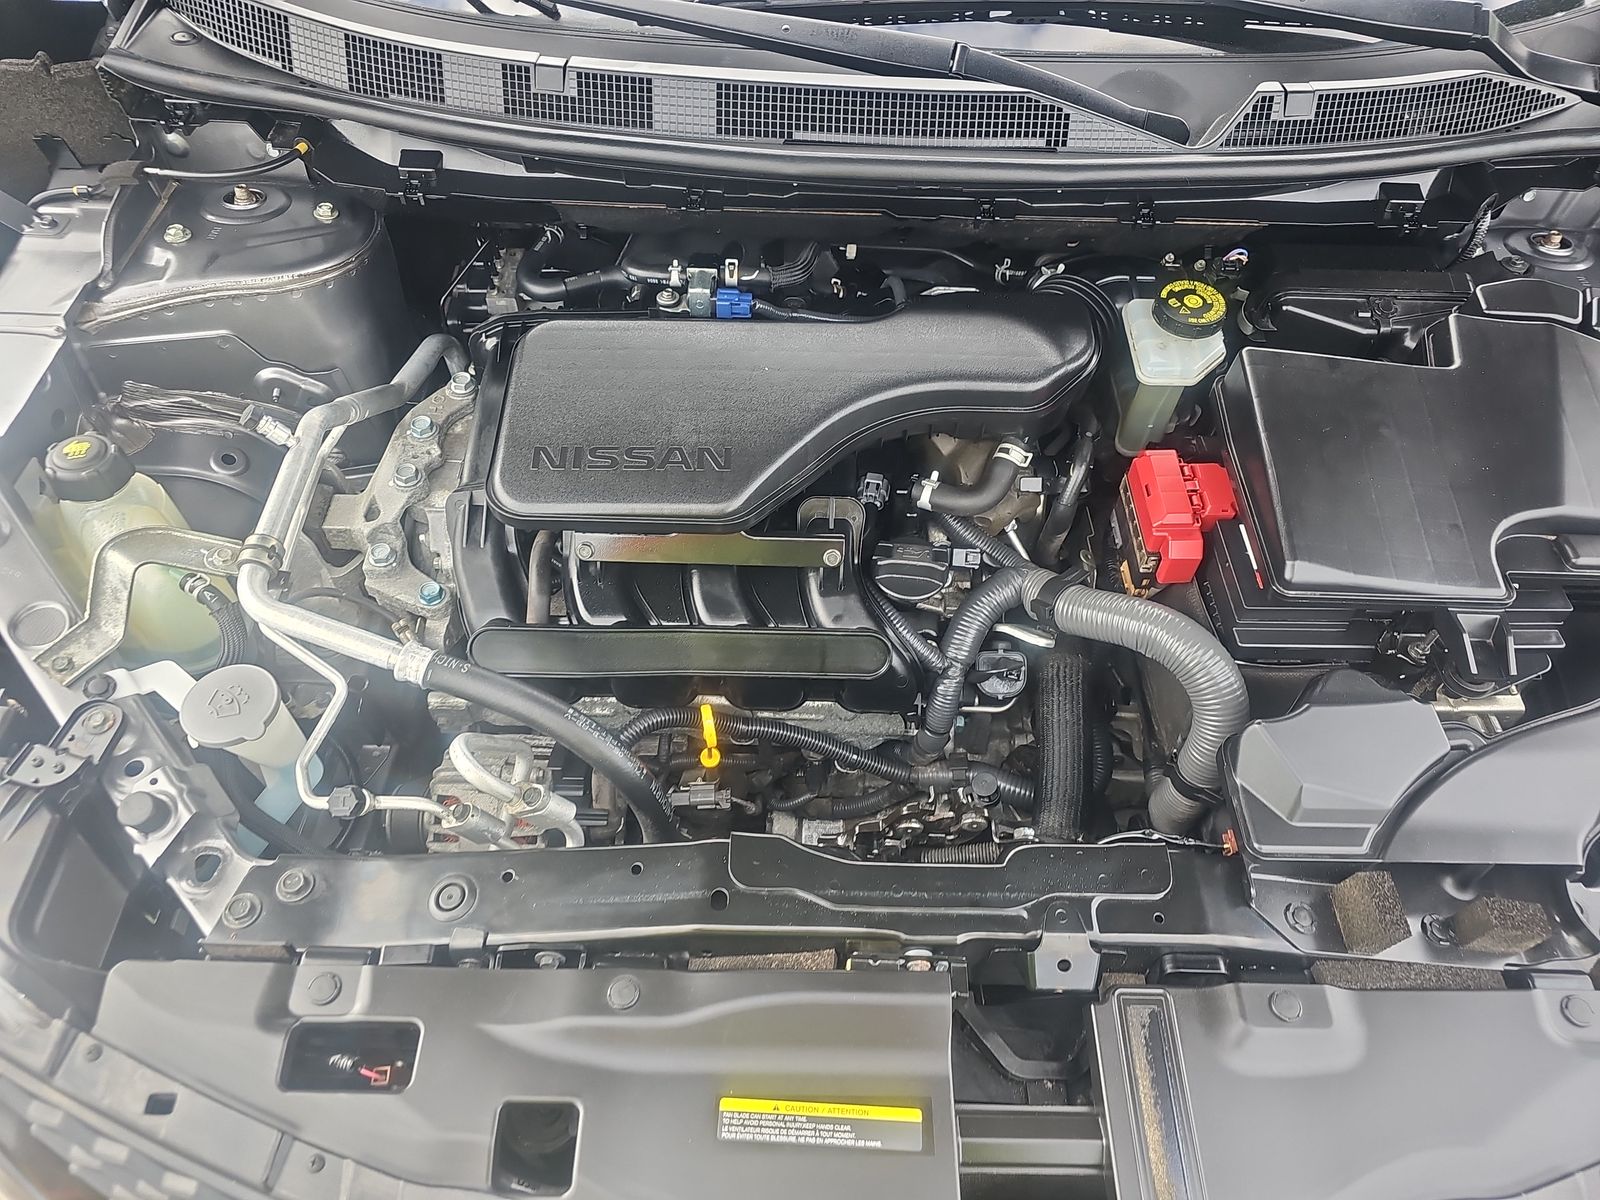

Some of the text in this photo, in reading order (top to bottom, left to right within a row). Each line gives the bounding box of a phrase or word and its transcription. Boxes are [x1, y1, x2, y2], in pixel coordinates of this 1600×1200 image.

[530, 445, 733, 471] NISSAN
[784, 1104, 818, 1112] CAUTION
[828, 1107, 868, 1115] ATTENTION
